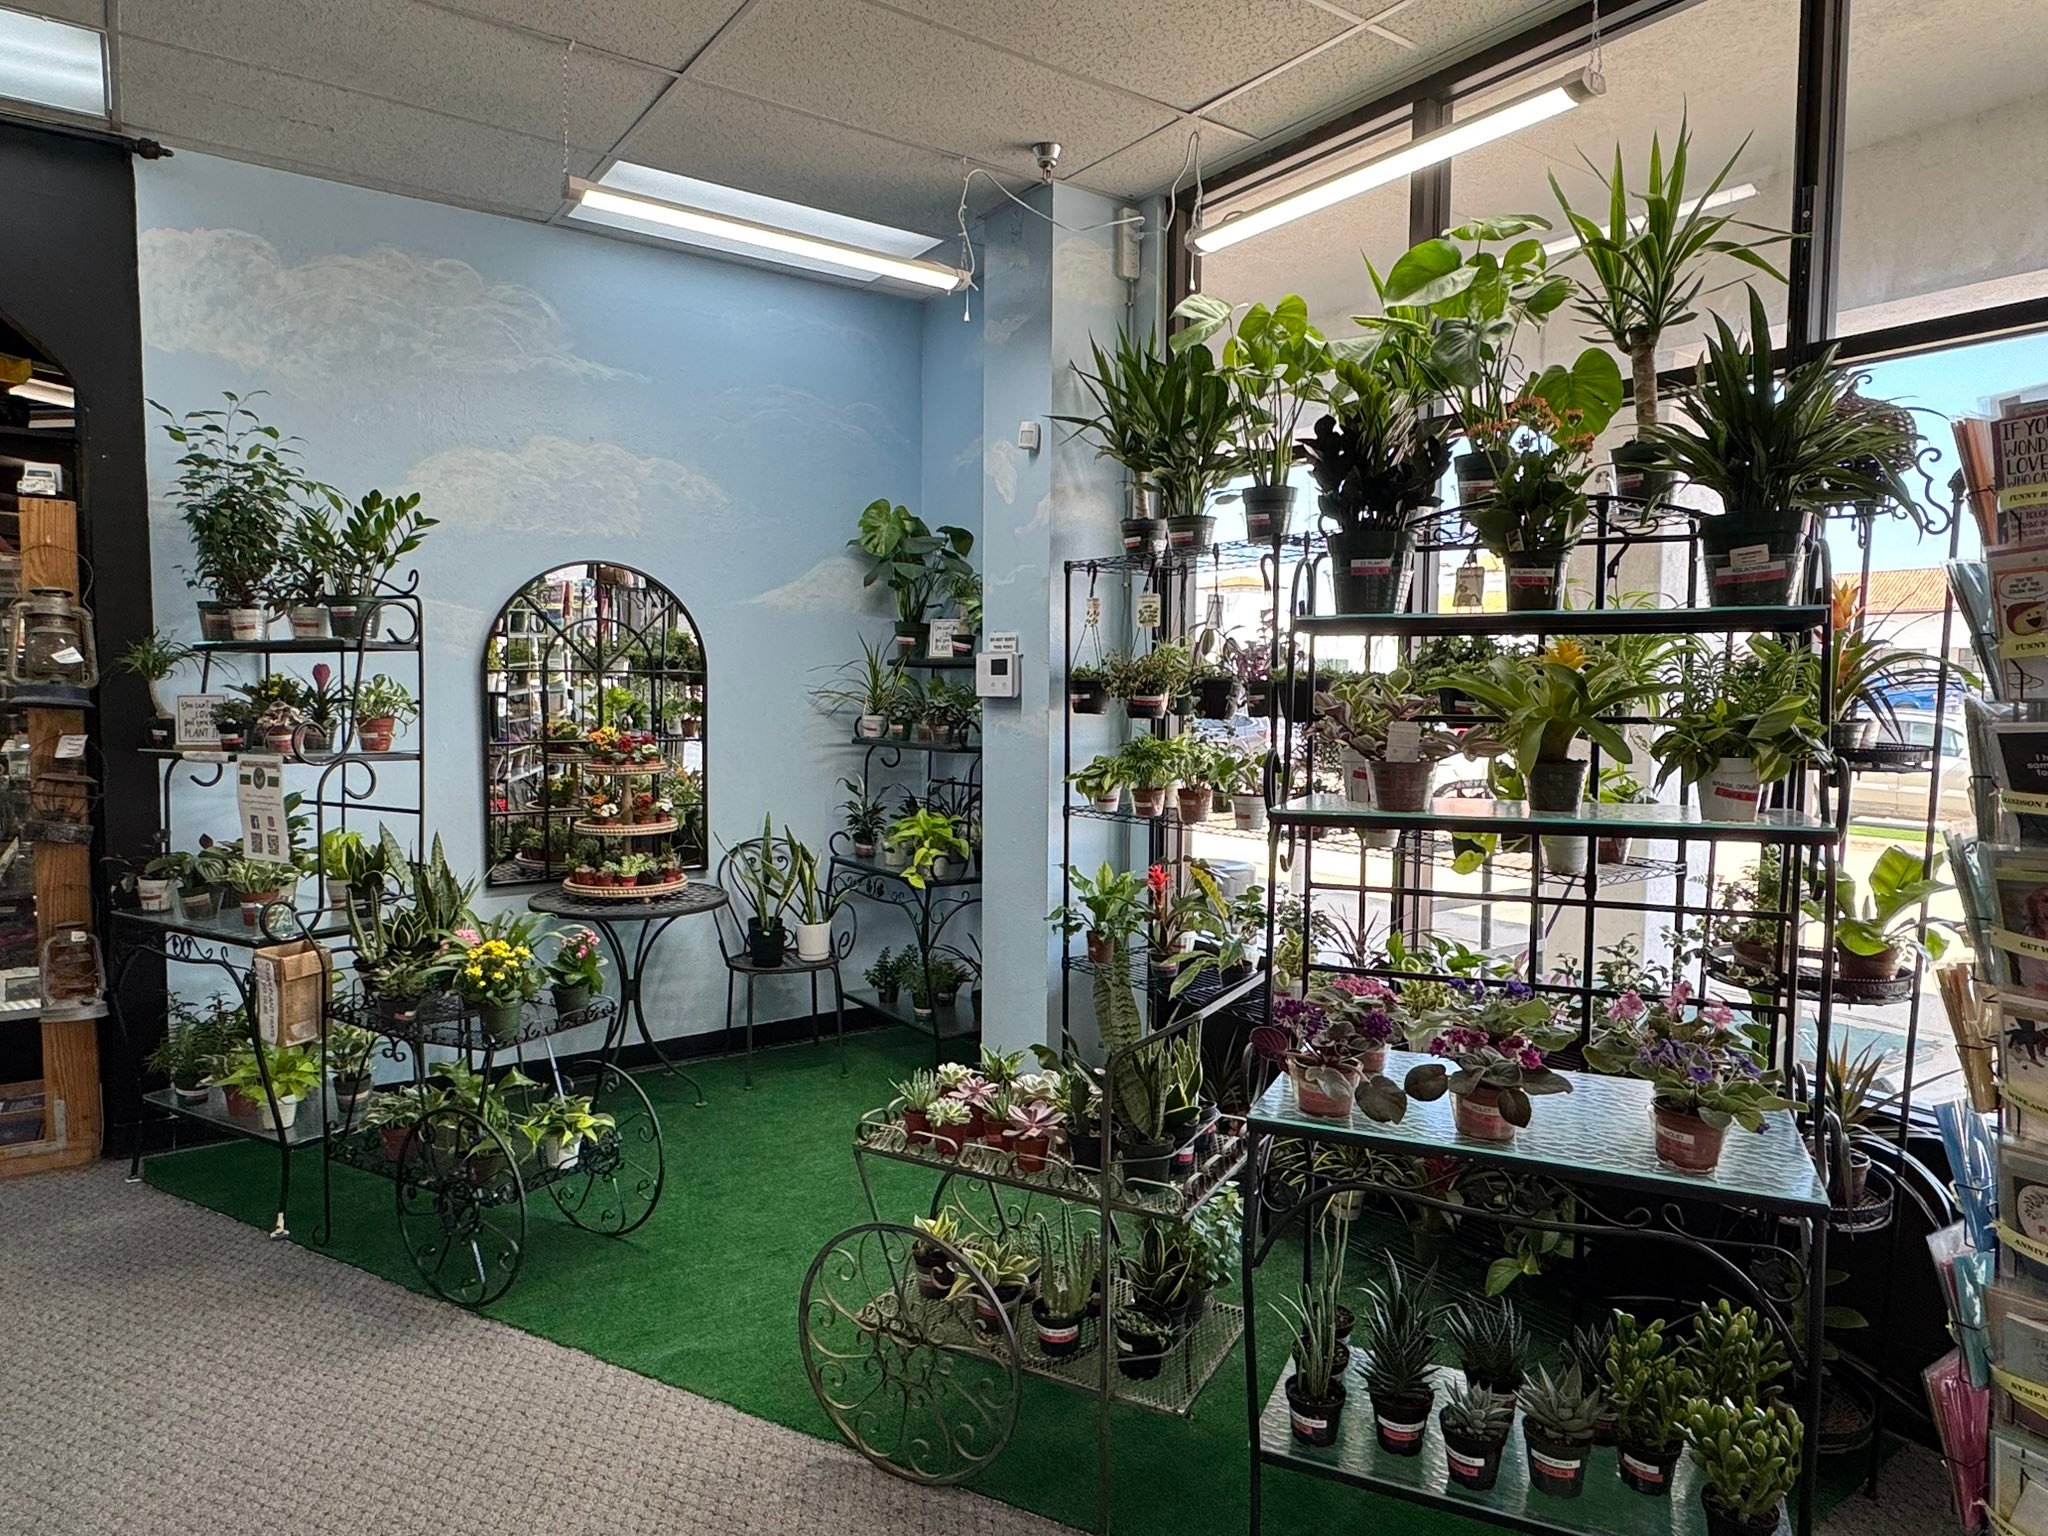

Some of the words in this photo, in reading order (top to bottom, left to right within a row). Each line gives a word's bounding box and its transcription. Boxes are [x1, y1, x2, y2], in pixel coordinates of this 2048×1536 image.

[2001, 421, 2020, 440] IF
[2023, 416, 2048, 437] YO
[2015, 641, 2046, 651] FUNNY
[2020, 941, 2039, 951] GET
